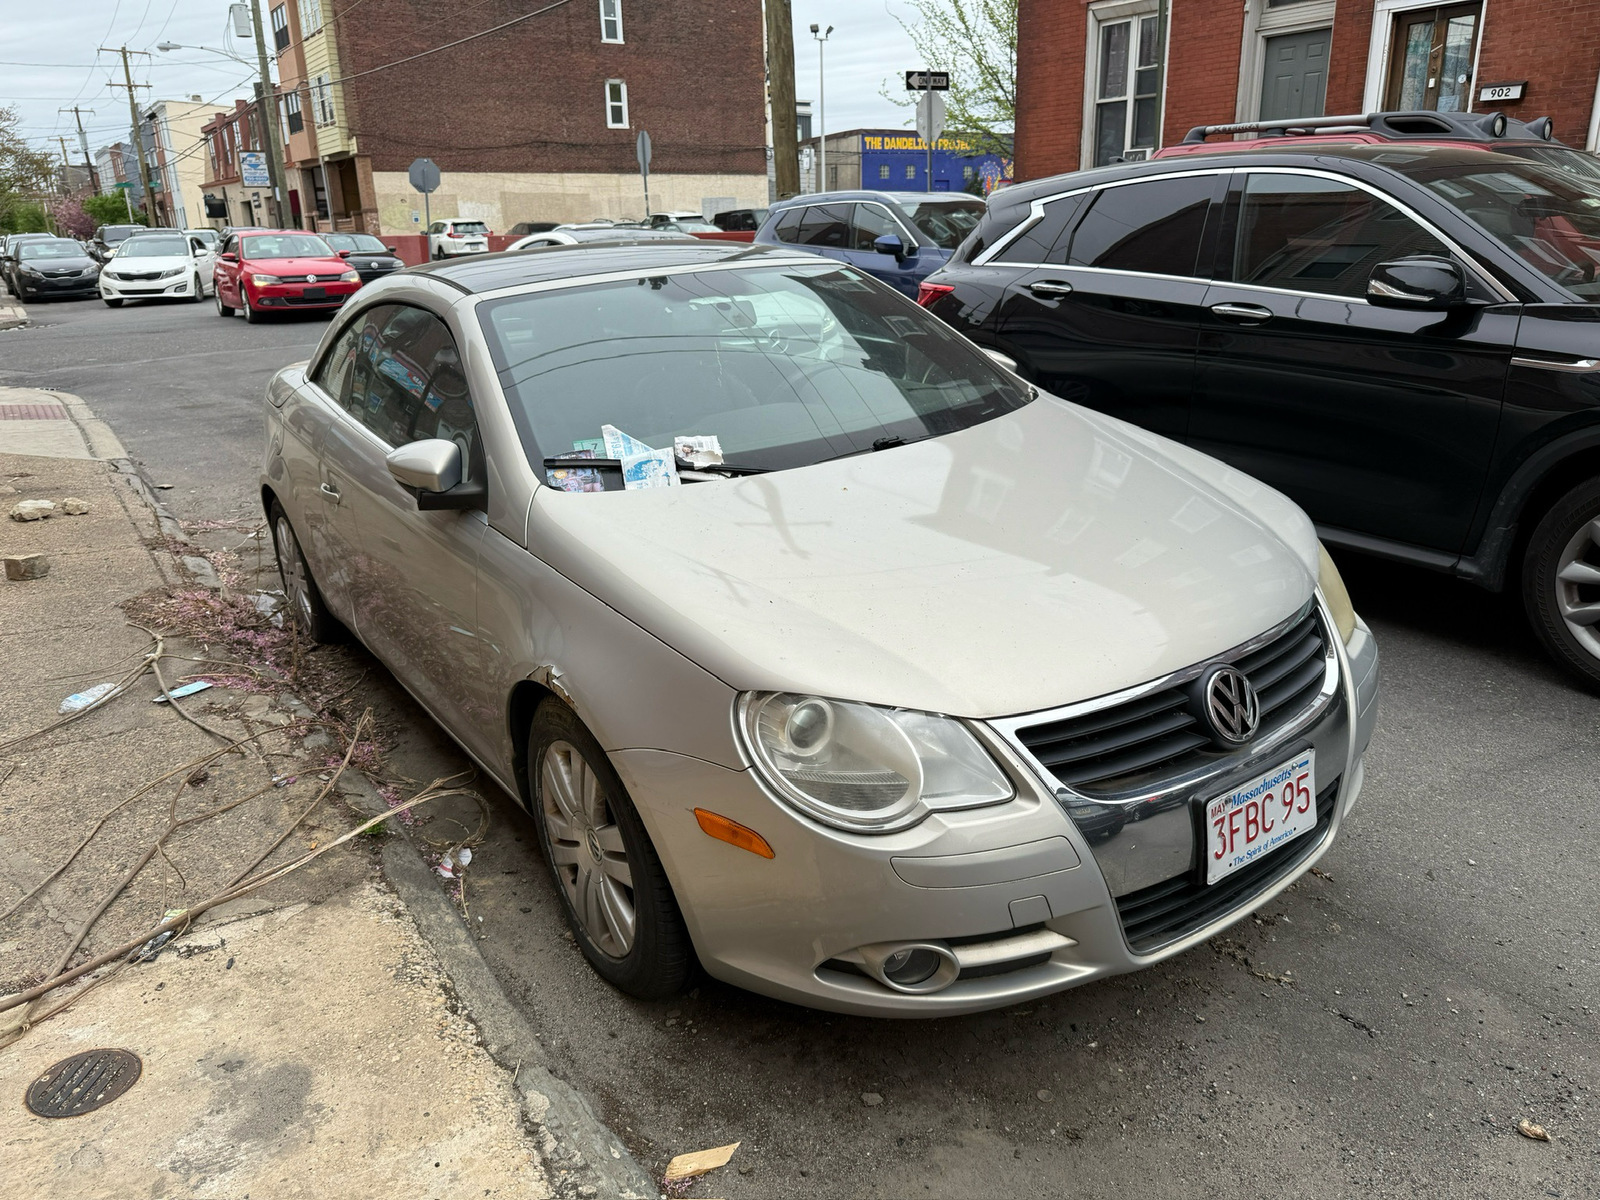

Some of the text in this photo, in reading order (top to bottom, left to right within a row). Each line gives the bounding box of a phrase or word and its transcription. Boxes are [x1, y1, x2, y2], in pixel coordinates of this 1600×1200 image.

[1491, 87, 1511, 98] 902
[864, 136, 882, 150] THE
[1230, 768, 1292, 809] Massachusetts
[1211, 802, 1226, 819] MAY
[1212, 771, 1310, 860] 3FBC 95
[1232, 855, 1246, 867] The
[1245, 844, 1262, 861] Spirit
[1262, 840, 1270, 852] of
